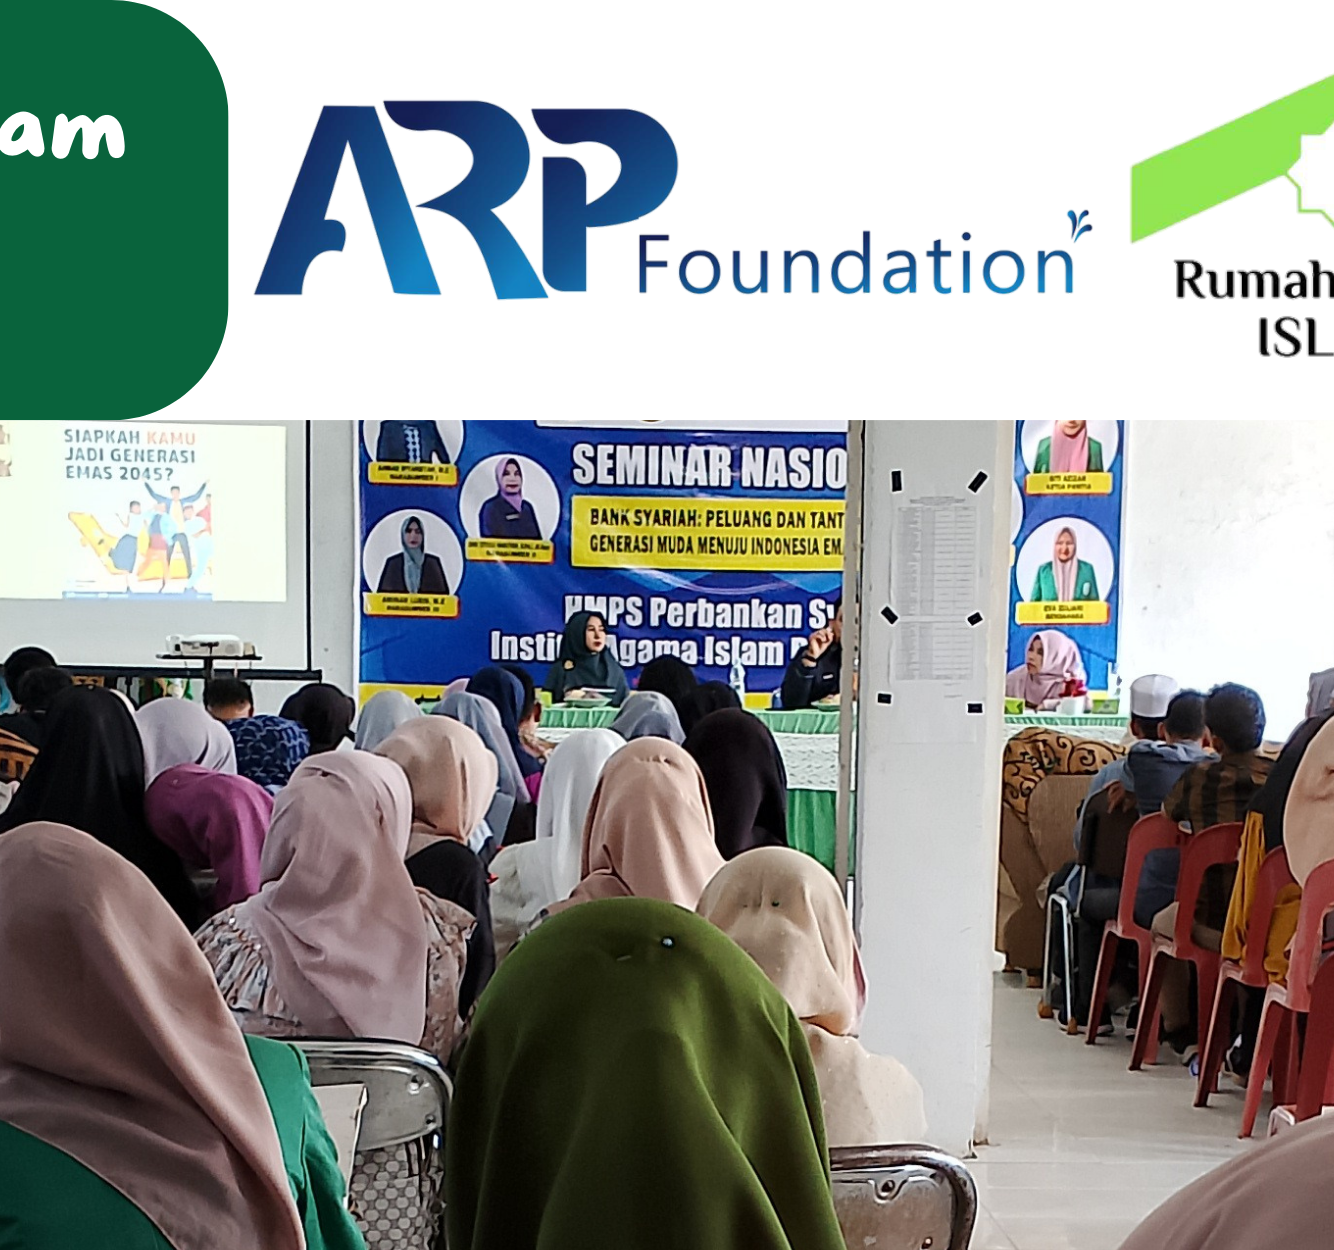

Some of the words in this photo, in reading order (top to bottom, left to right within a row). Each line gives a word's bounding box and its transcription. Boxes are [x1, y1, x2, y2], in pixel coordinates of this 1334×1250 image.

[64, 429, 140, 444] SIAPKAH
[147, 431, 196, 445] KAMU
[65, 447, 104, 461] JADI
[110, 448, 195, 463] GENERASI
[572, 443, 732, 488] SEMINAR
[66, 465, 113, 480] EMAS
[119, 466, 174, 481] 2045?
[590, 508, 630, 527] BANK
[634, 509, 702, 528] SYARIAH:
[706, 510, 772, 529] PELUANG
[777, 511, 806, 529] DAN
[590, 534, 654, 553] GENERASI
[657, 535, 693, 554] MUDA
[697, 537, 748, 555] MENUJU
[751, 537, 820, 556] INDONESIA
[824, 538, 844, 556] EM
[650, 597, 803, 629] Perbankan
[704, 636, 784, 666] Islam
